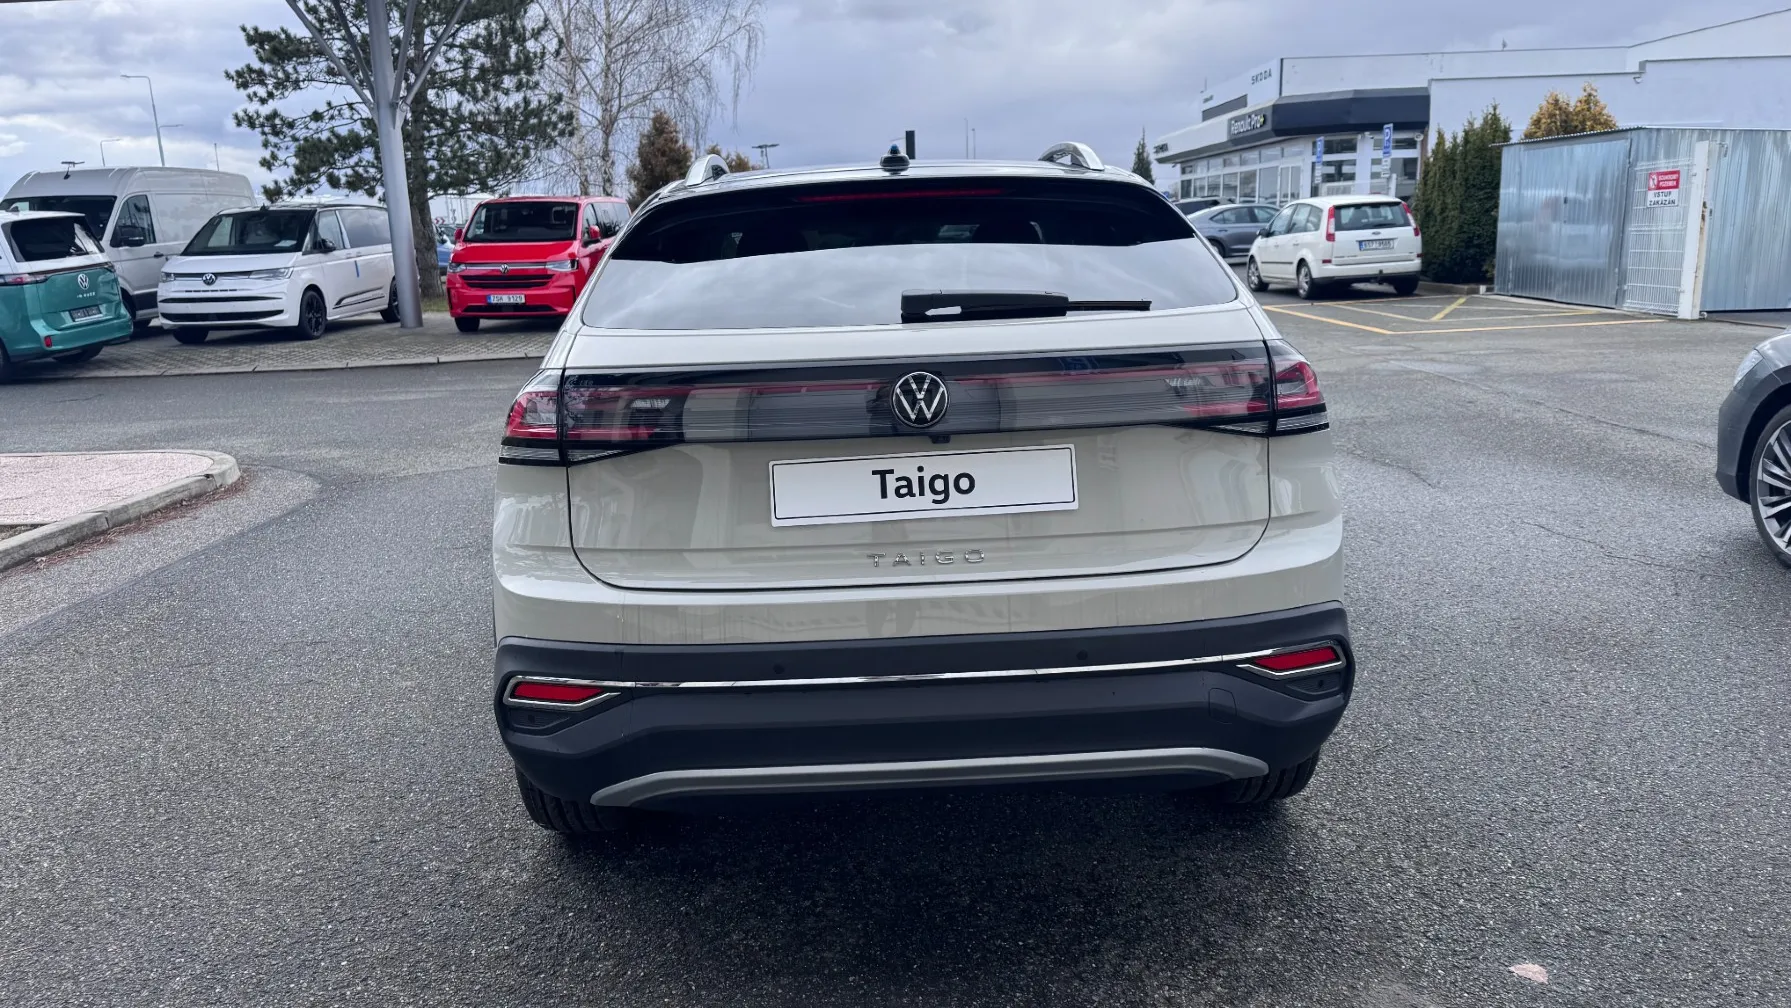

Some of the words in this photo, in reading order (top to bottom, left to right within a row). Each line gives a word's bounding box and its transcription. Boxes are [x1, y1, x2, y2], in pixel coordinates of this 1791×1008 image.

[892, 371, 948, 428] VW
[871, 465, 976, 505] Taigo
[866, 549, 985, 567] TAIGO
